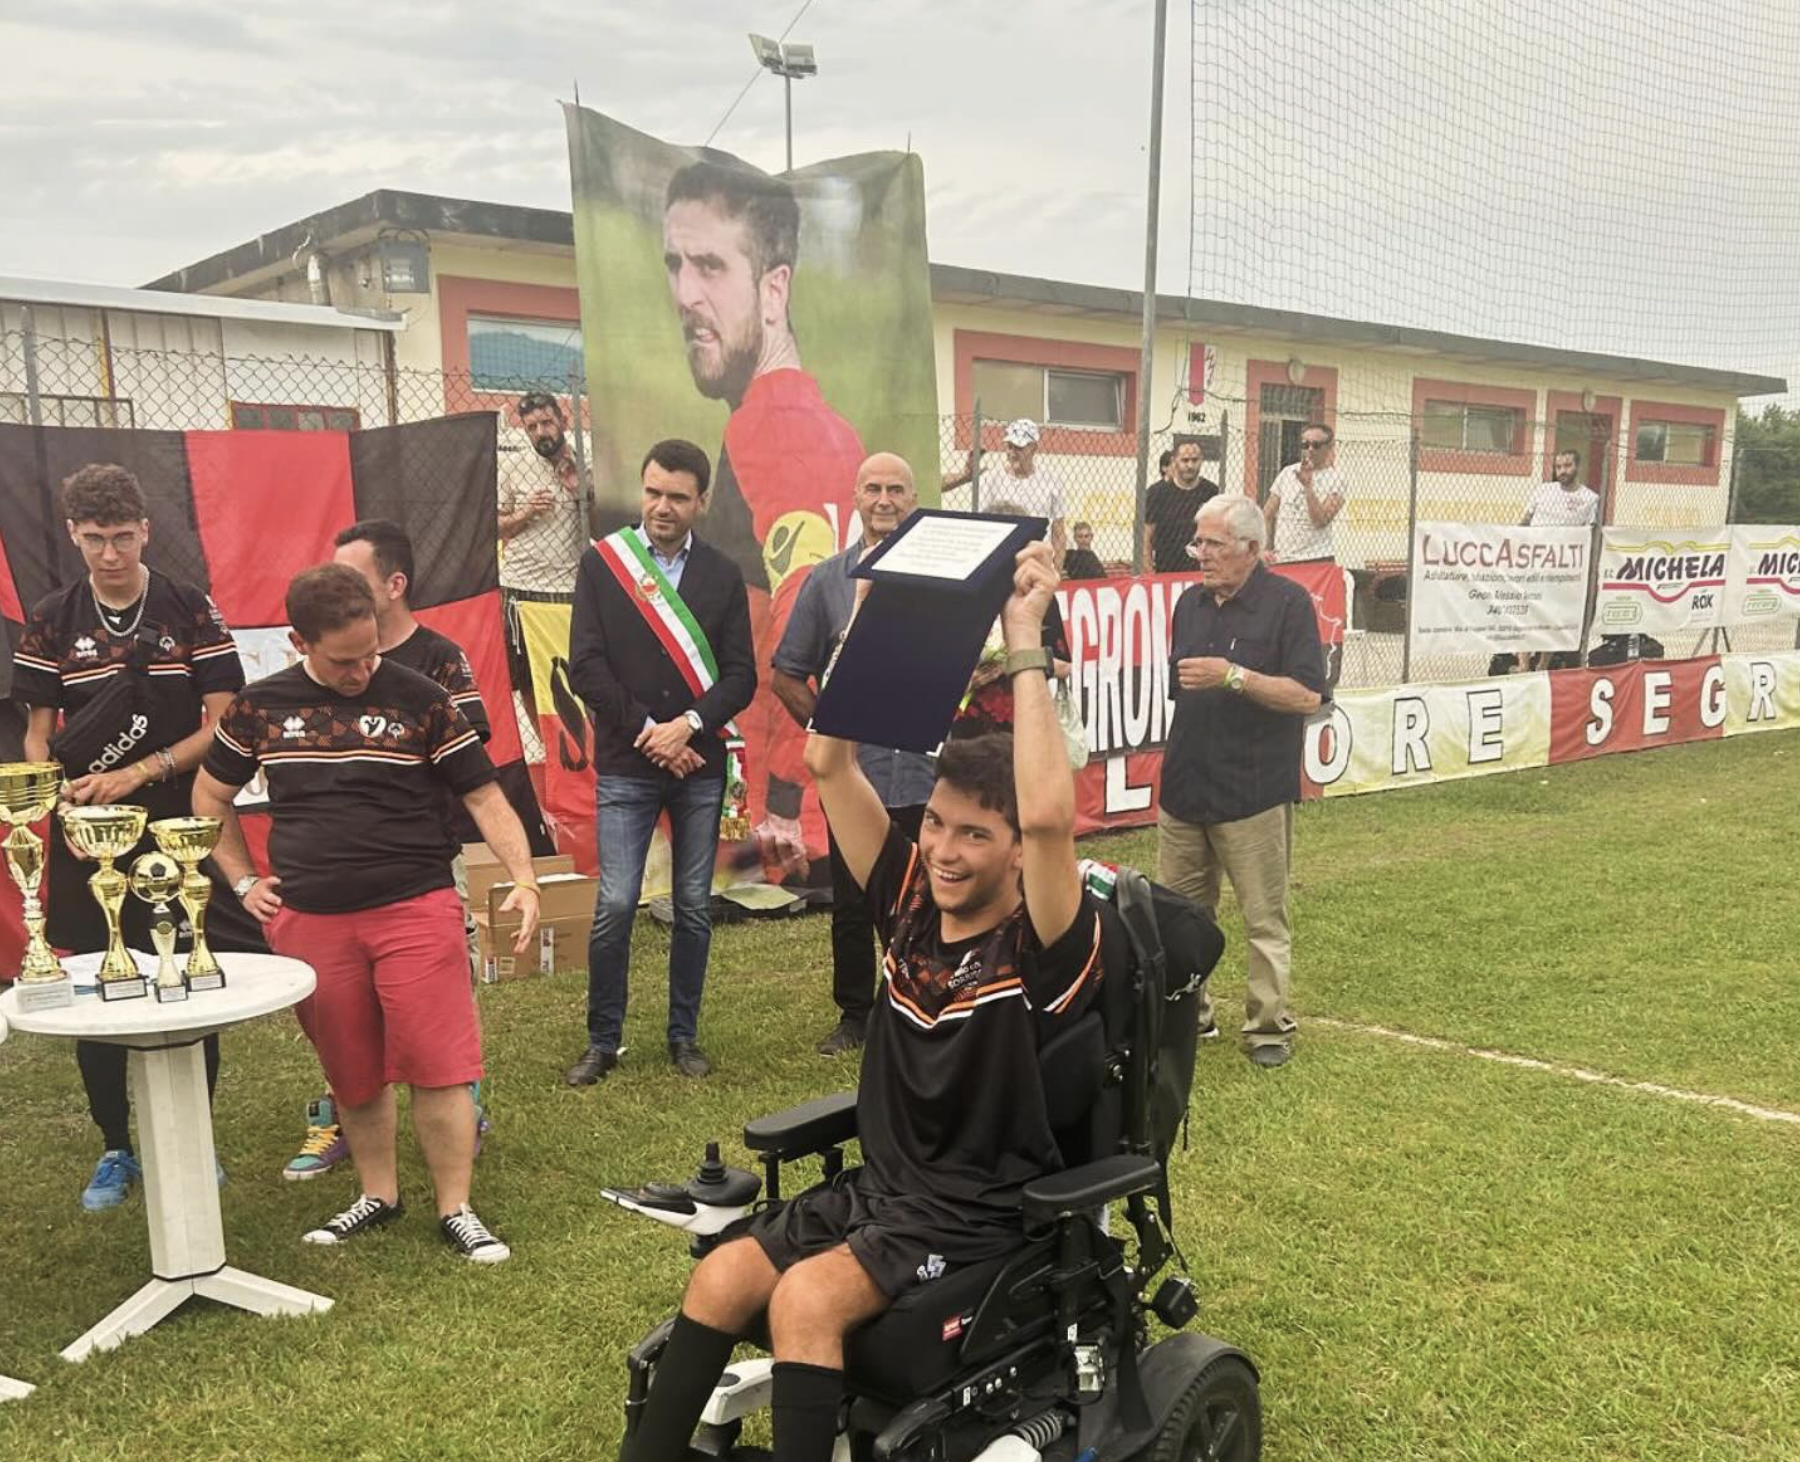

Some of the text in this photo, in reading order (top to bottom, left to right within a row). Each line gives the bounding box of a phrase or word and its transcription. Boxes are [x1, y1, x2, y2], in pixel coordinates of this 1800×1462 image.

[1616, 553, 1726, 581] MICHELA
[1757, 552, 1800, 576] MIC
[1054, 582, 1194, 753] GROM
[1585, 661, 1777, 747] SEGR
[88, 713, 149, 774] adidas
